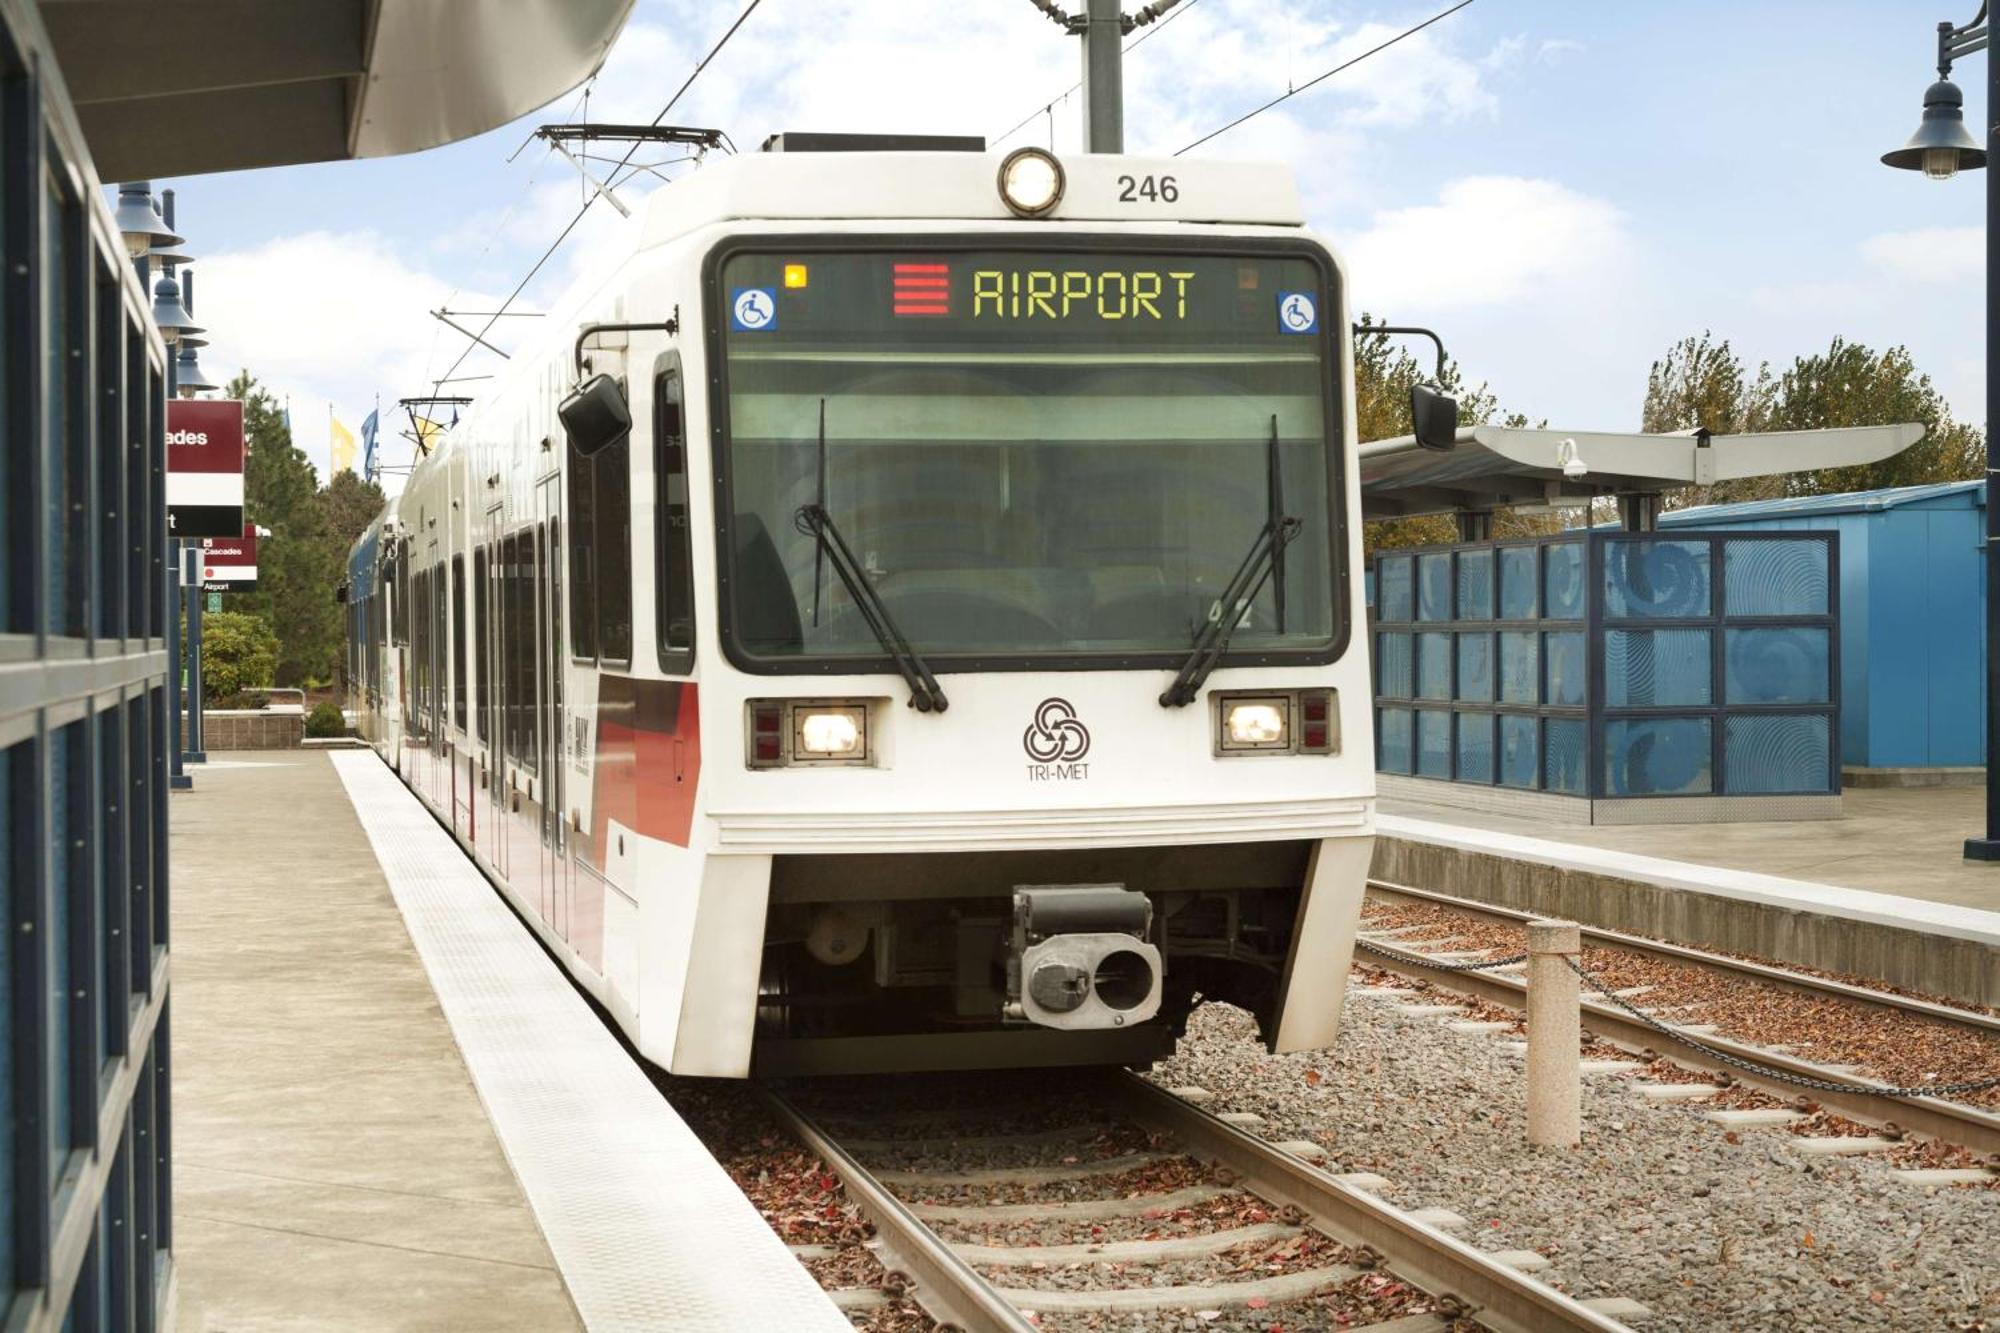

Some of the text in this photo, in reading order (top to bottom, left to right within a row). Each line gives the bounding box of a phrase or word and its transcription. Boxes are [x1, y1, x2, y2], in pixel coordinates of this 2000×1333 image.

[1117, 175, 1179, 203] 246
[974, 271, 1196, 319] AIRPORT
[204, 548, 242, 556] Cascades
[204, 583, 229, 592] Airport
[1026, 763, 1089, 781] TRI-MET
